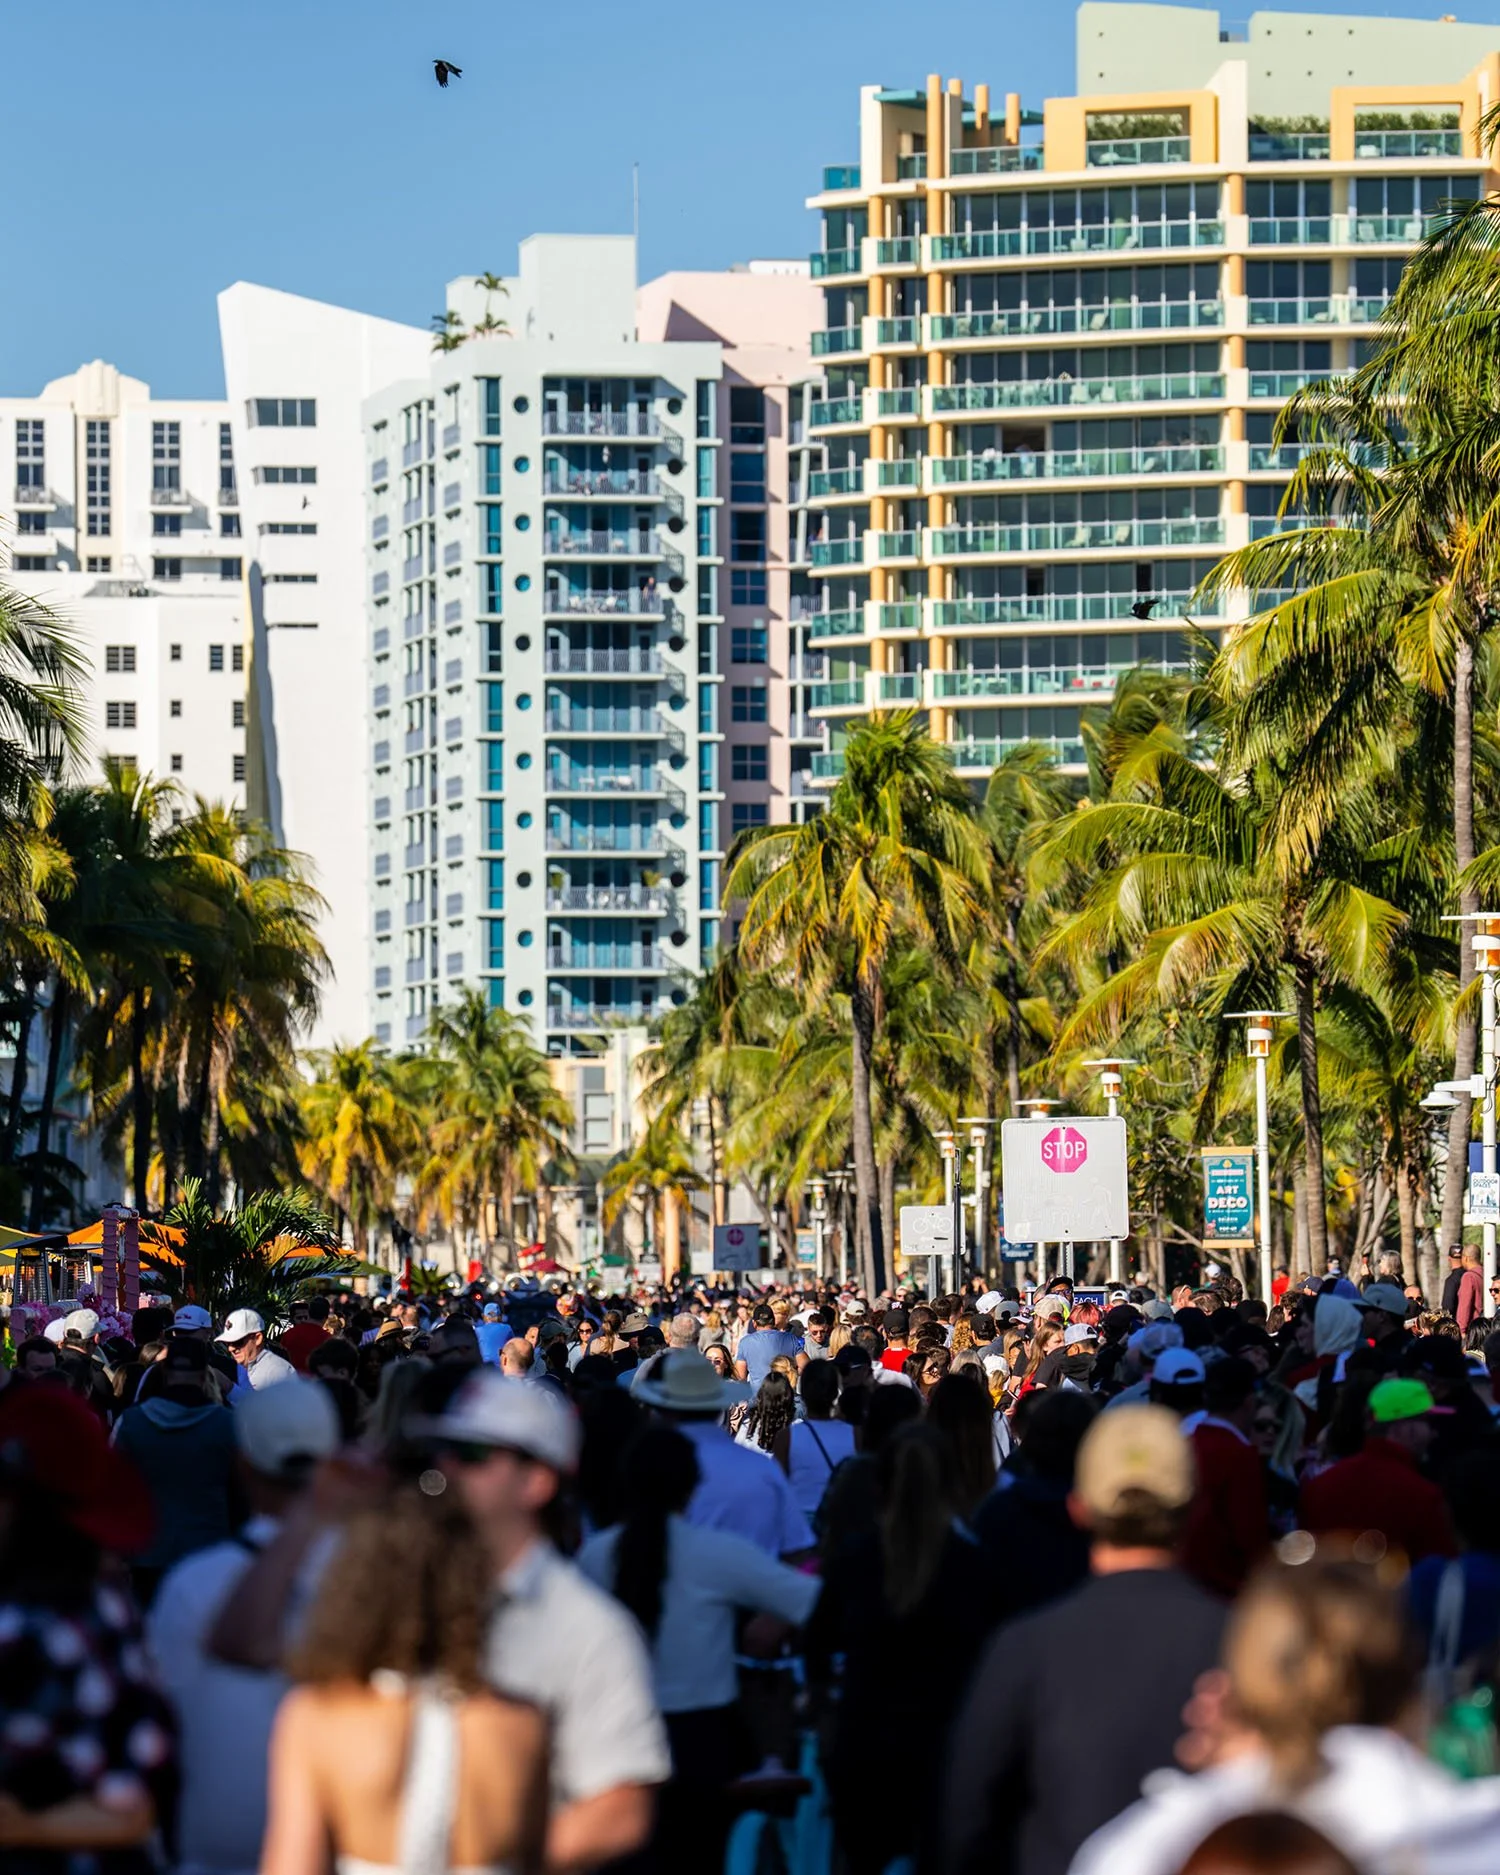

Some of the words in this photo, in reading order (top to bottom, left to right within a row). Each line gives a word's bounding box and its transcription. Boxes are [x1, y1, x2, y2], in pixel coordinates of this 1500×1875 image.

[1043, 1141, 1085, 1159] STOP
[1216, 1185, 1239, 1195] ART
[1207, 1196, 1248, 1209] DECO
[1073, 1297, 1098, 1306] EACH
